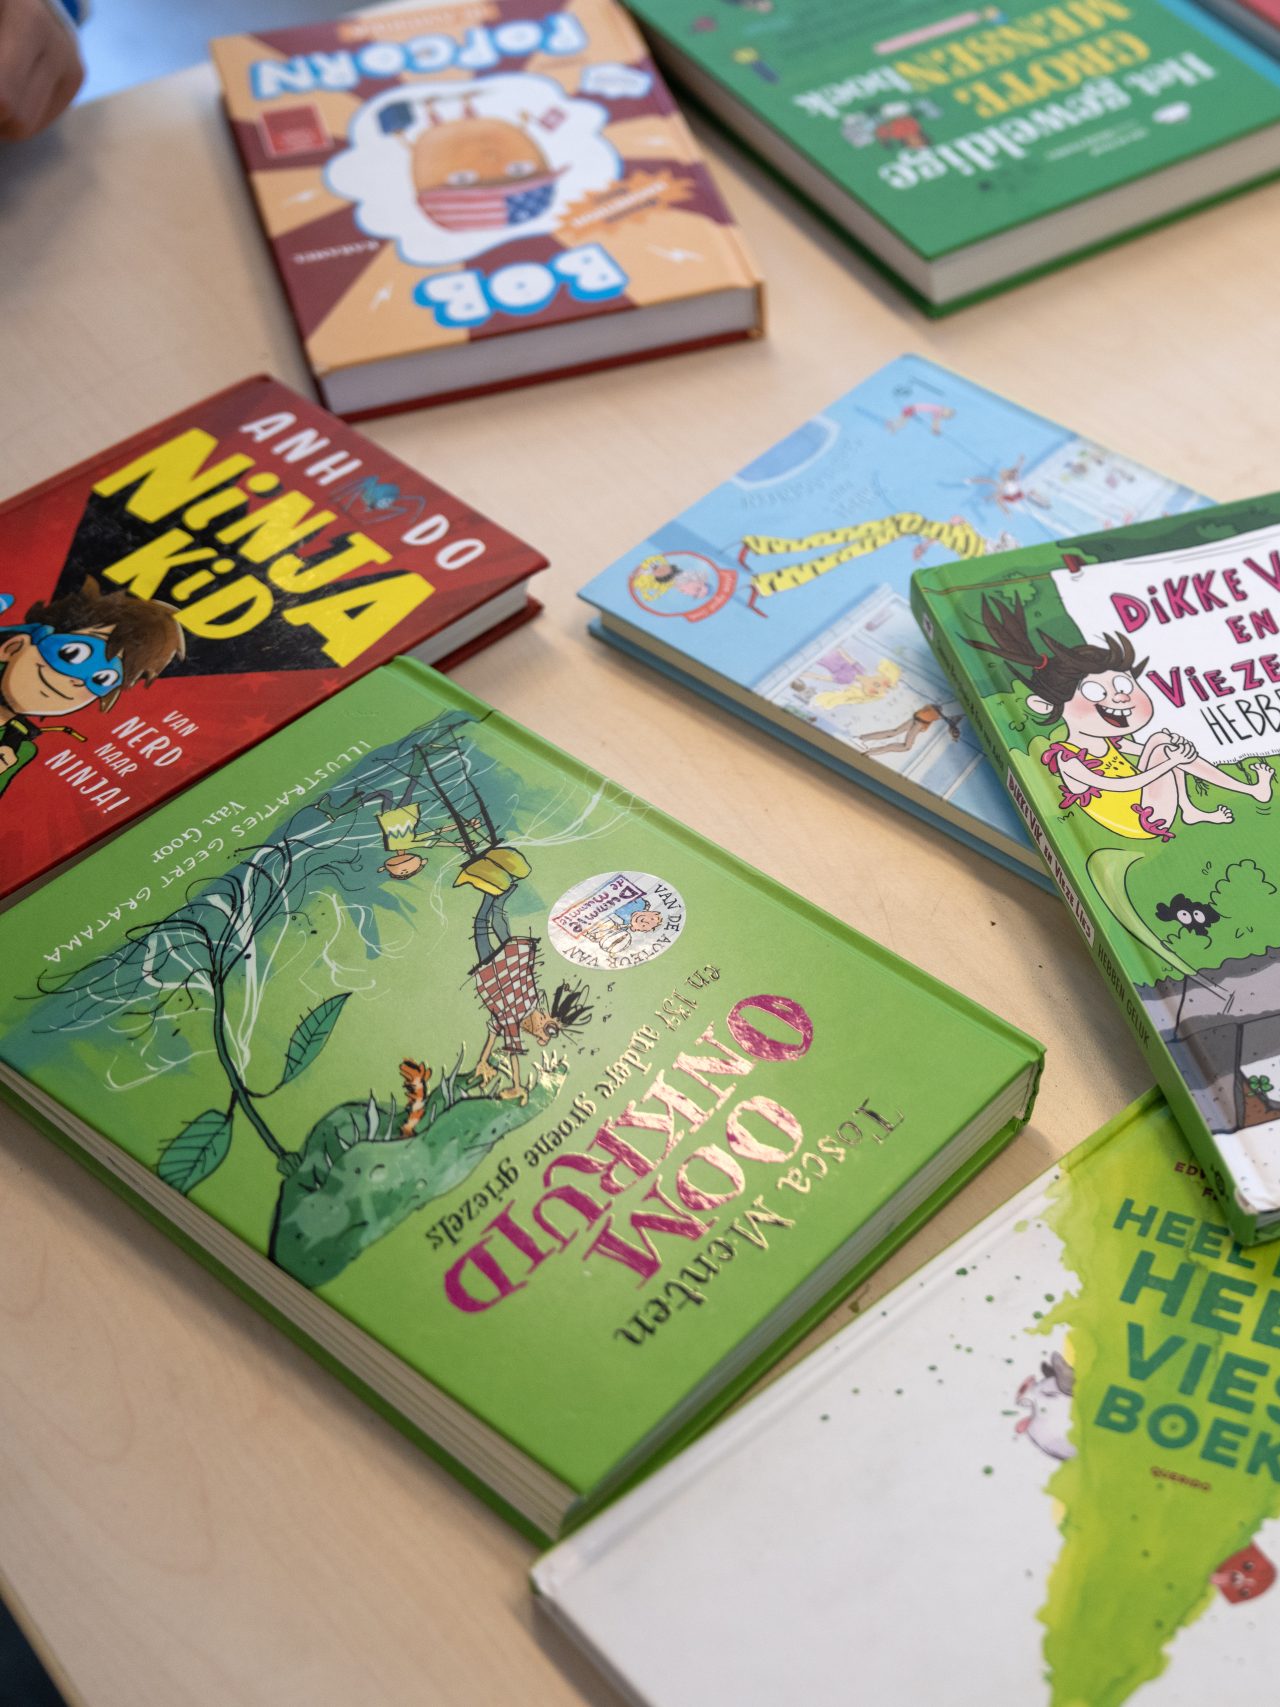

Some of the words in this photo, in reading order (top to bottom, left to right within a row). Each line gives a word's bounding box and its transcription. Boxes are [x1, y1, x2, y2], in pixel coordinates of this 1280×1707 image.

[251, 13, 588, 99] POPCORN
[1124, 52, 1217, 97] Het
[879, 76, 1132, 189] geweldige
[413, 243, 629, 328] BOB
[239, 411, 365, 487] ANH
[402, 514, 486, 570] DO
[1225, 608, 1280, 644] EN
[111, 715, 183, 768] NERD
[161, 709, 197, 738] VAN
[45, 748, 130, 815] NINJA!
[94, 743, 139, 779] NAAR
[231, 740, 372, 839] ILLUSTRATIES
[152, 827, 202, 864] Goor
[203, 801, 247, 827] Van
[161, 837, 225, 889] GEERT
[610, 879, 624, 890] de
[44, 886, 151, 963] GRATAMA
[569, 886, 640, 932] Dummie
[654, 884, 681, 911] VAN
[664, 914, 681, 932] DE
[562, 946, 600, 967] VAN
[607, 934, 671, 968] AUTEUR
[686, 964, 721, 990] en
[1097, 944, 1125, 1001] HEBBEN
[1126, 997, 1150, 1049] GELUK
[595, 1023, 660, 1099] andere
[444, 993, 814, 1314] ONKRUID
[524, 1091, 597, 1167] groene
[777, 1097, 905, 1195] Tosca
[425, 1156, 520, 1251] griezels
[583, 1096, 804, 1290] OOM
[1111, 1197, 1258, 1271] HEEL
[612, 1193, 797, 1348] Menten
